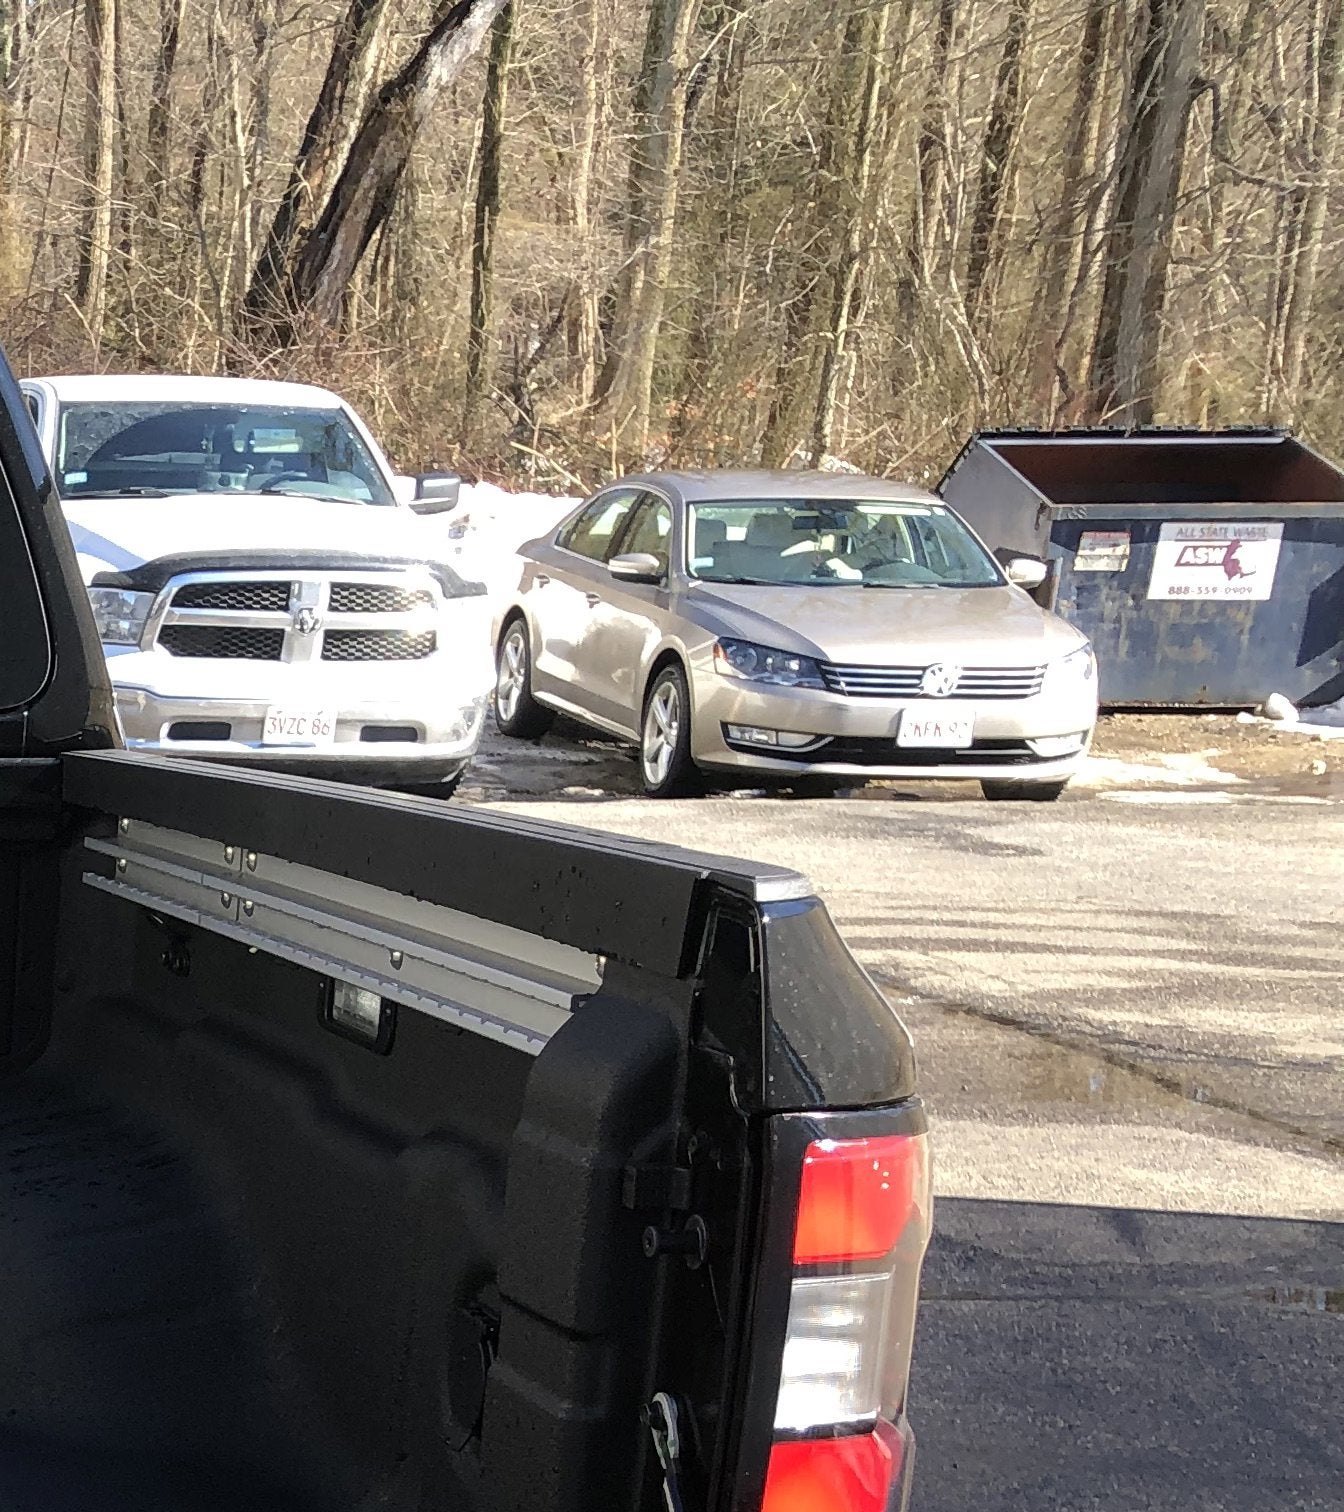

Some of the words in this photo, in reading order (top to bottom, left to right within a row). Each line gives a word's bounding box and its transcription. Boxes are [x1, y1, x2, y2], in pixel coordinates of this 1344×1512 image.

[1176, 526, 1196, 538] ALL
[1199, 526, 1229, 538] STATE
[1179, 547, 1227, 565] ASW
